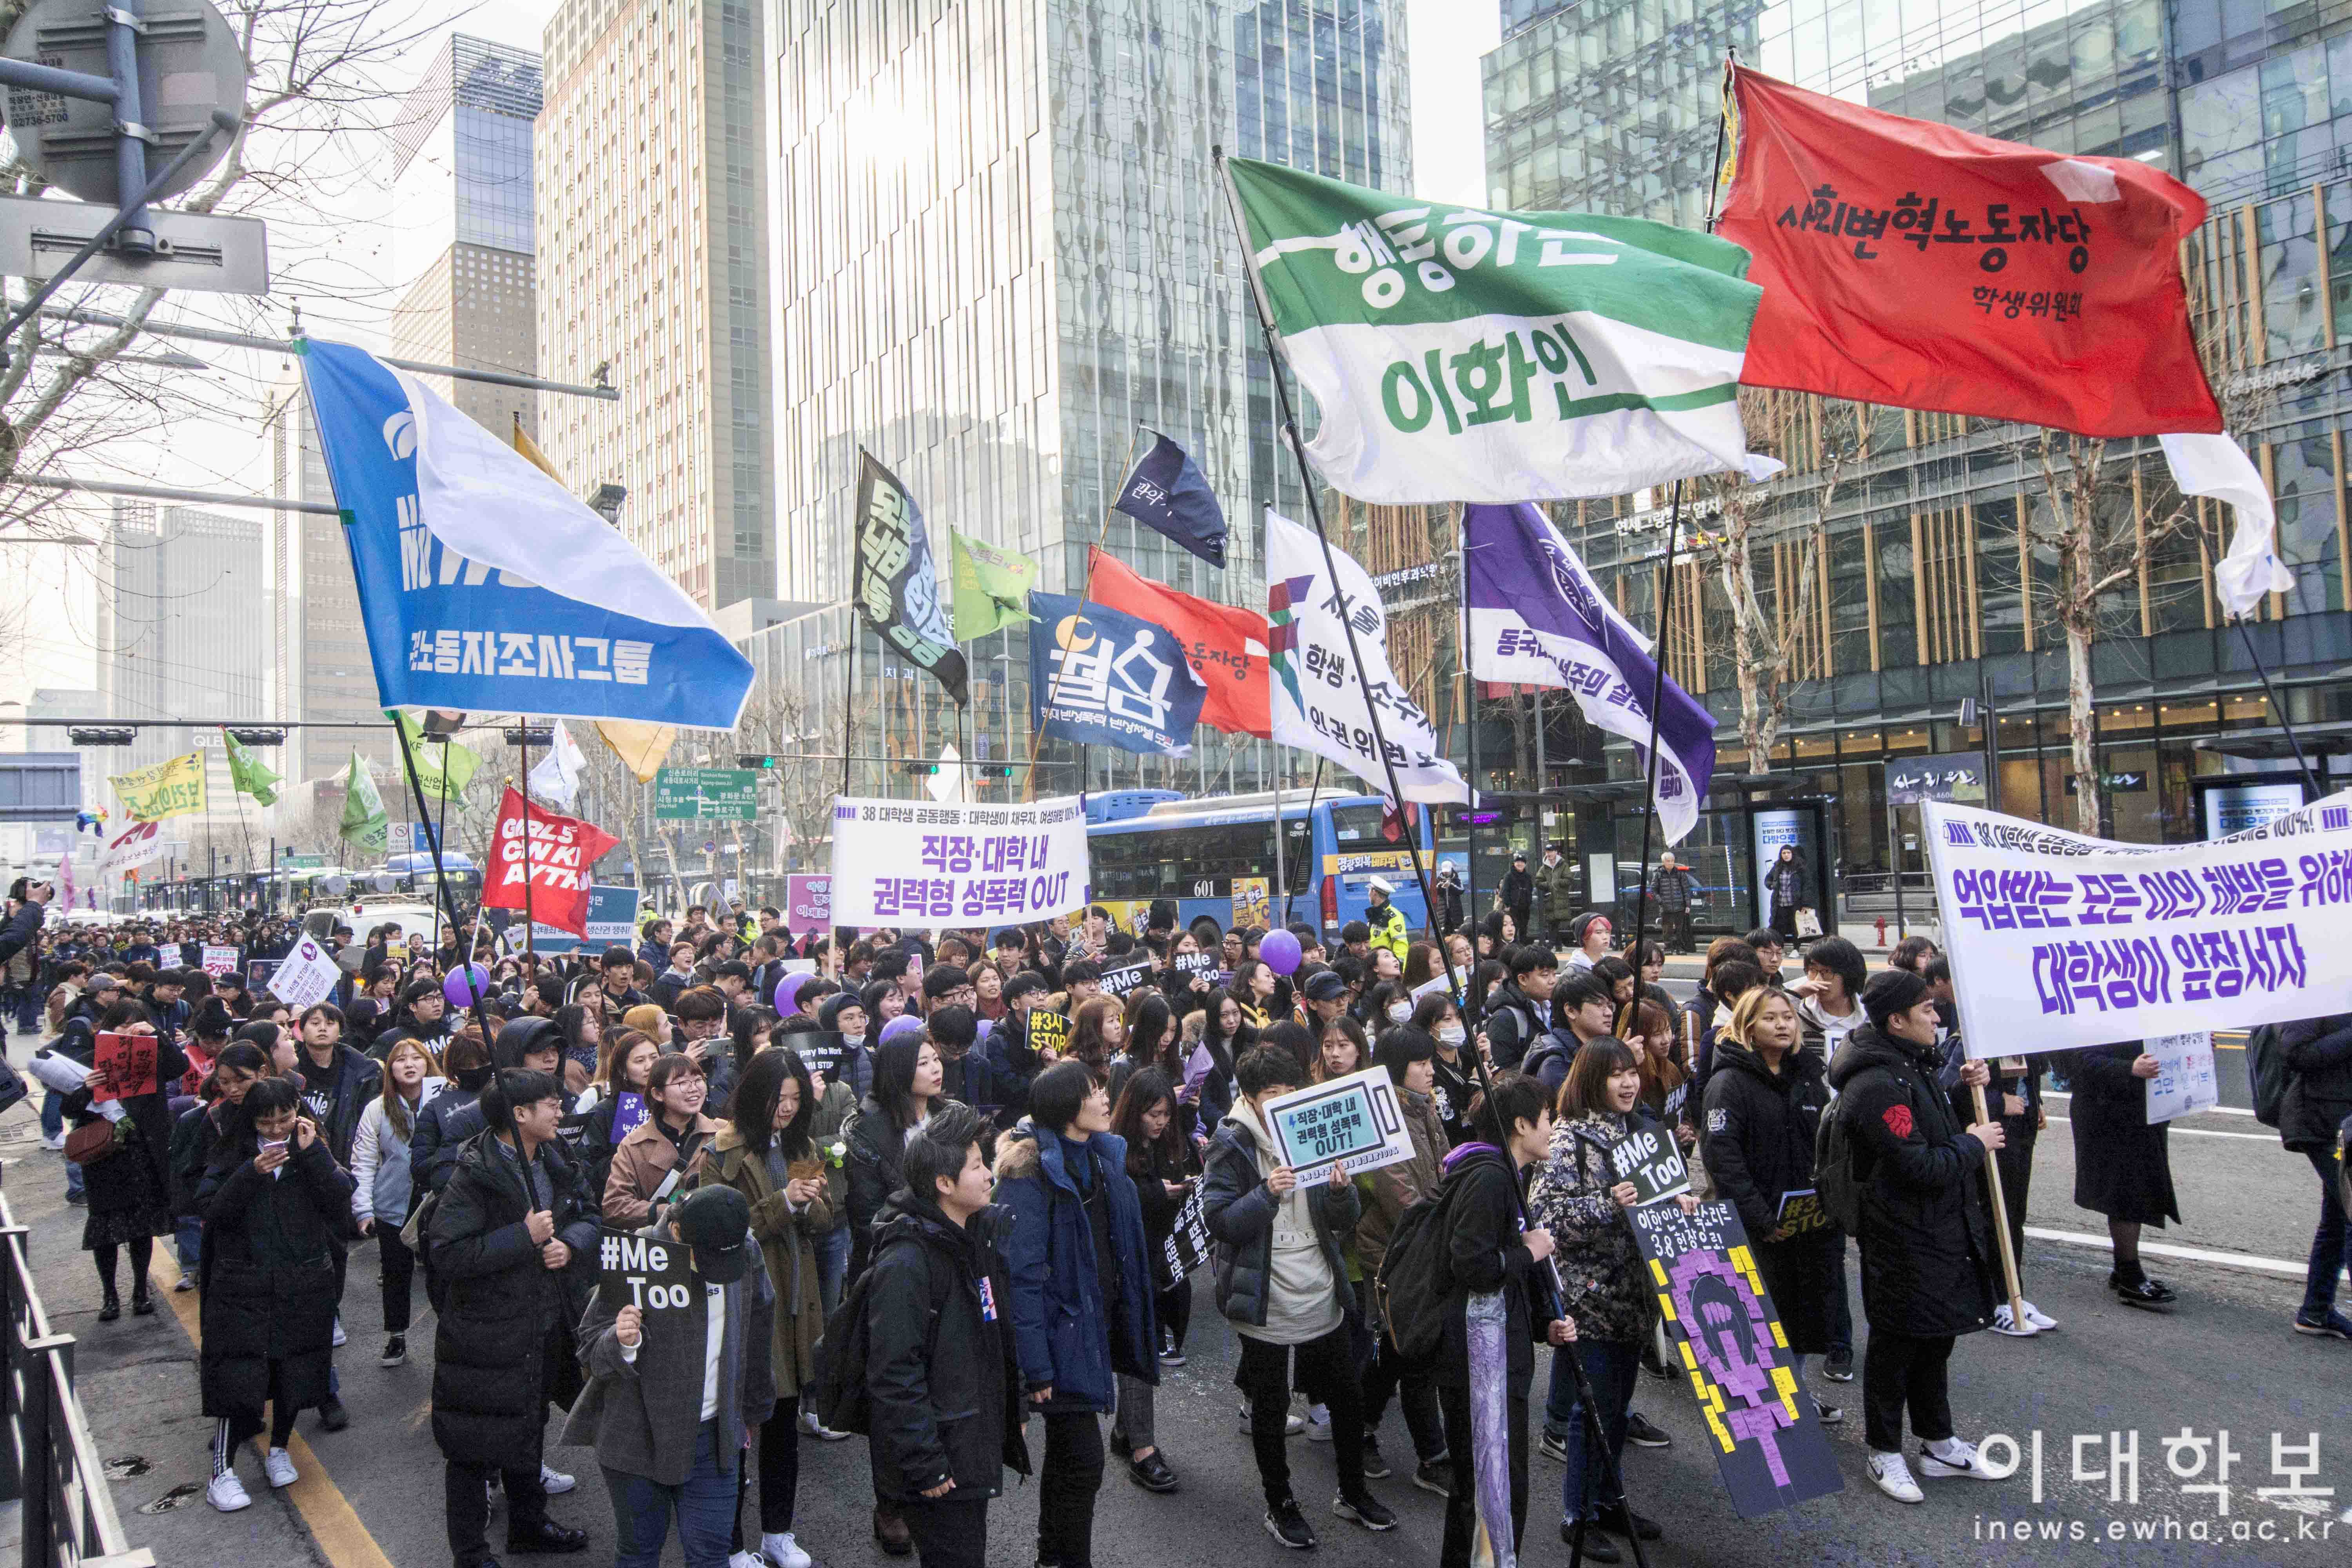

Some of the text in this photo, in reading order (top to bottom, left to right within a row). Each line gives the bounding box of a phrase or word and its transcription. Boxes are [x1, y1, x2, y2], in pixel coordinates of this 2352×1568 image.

[1776, 183, 2092, 274] 사회변혁노동자당
[1333, 205, 1628, 310] 행동하는
[1973, 285, 2083, 322] 학생위원회
[1381, 321, 1599, 436] 이화인
[884, 667, 914, 680] 치과
[720, 792, 740, 800] 광화문
[879, 806, 914, 824] 대학생
[916, 808, 960, 825] 공동행동
[969, 811, 1009, 826] 대학생이
[1040, 809, 1063, 825] 여성해방
[1762, 834, 1796, 844] 다방으로
[922, 834, 1049, 874] 직장·대학 내
[873, 871, 1069, 917] 권력형 성폭력 OUT
[1194, 880, 1214, 897] 601
[1953, 869, 2074, 930] 억압받는
[2076, 873, 2142, 925] 모든
[2138, 869, 2206, 920] 이의
[2202, 858, 2294, 916] 해방을
[796, 904, 828, 918] 이제는
[612, 926, 631, 935] 쟁취!
[205, 962, 234, 975] STOP
[297, 962, 312, 981] STOP!
[1176, 953, 1211, 971] #Me
[2032, 923, 2307, 1016] 대학생이 앞장서자
[1100, 969, 1143, 994] #Me
[1192, 968, 1220, 982] Too
[1030, 1010, 1063, 1031] #3시
[799, 1047, 843, 1058] pay No Work
[817, 1061, 834, 1069] STOP
[1296, 1096, 1357, 1125] 직장·대학 내
[1296, 1113, 1362, 1144] 권력형 성폭력
[1315, 1131, 1354, 1157] OUT!
[1611, 1129, 1659, 1179] #Me
[1639, 1155, 1681, 1195] Too
[1637, 1207, 1688, 1232] 이화인의
[601, 1236, 669, 1272] #Me
[1651, 1228, 1725, 1258] 3.8 현장으로!
[626, 1276, 690, 1310] Too
